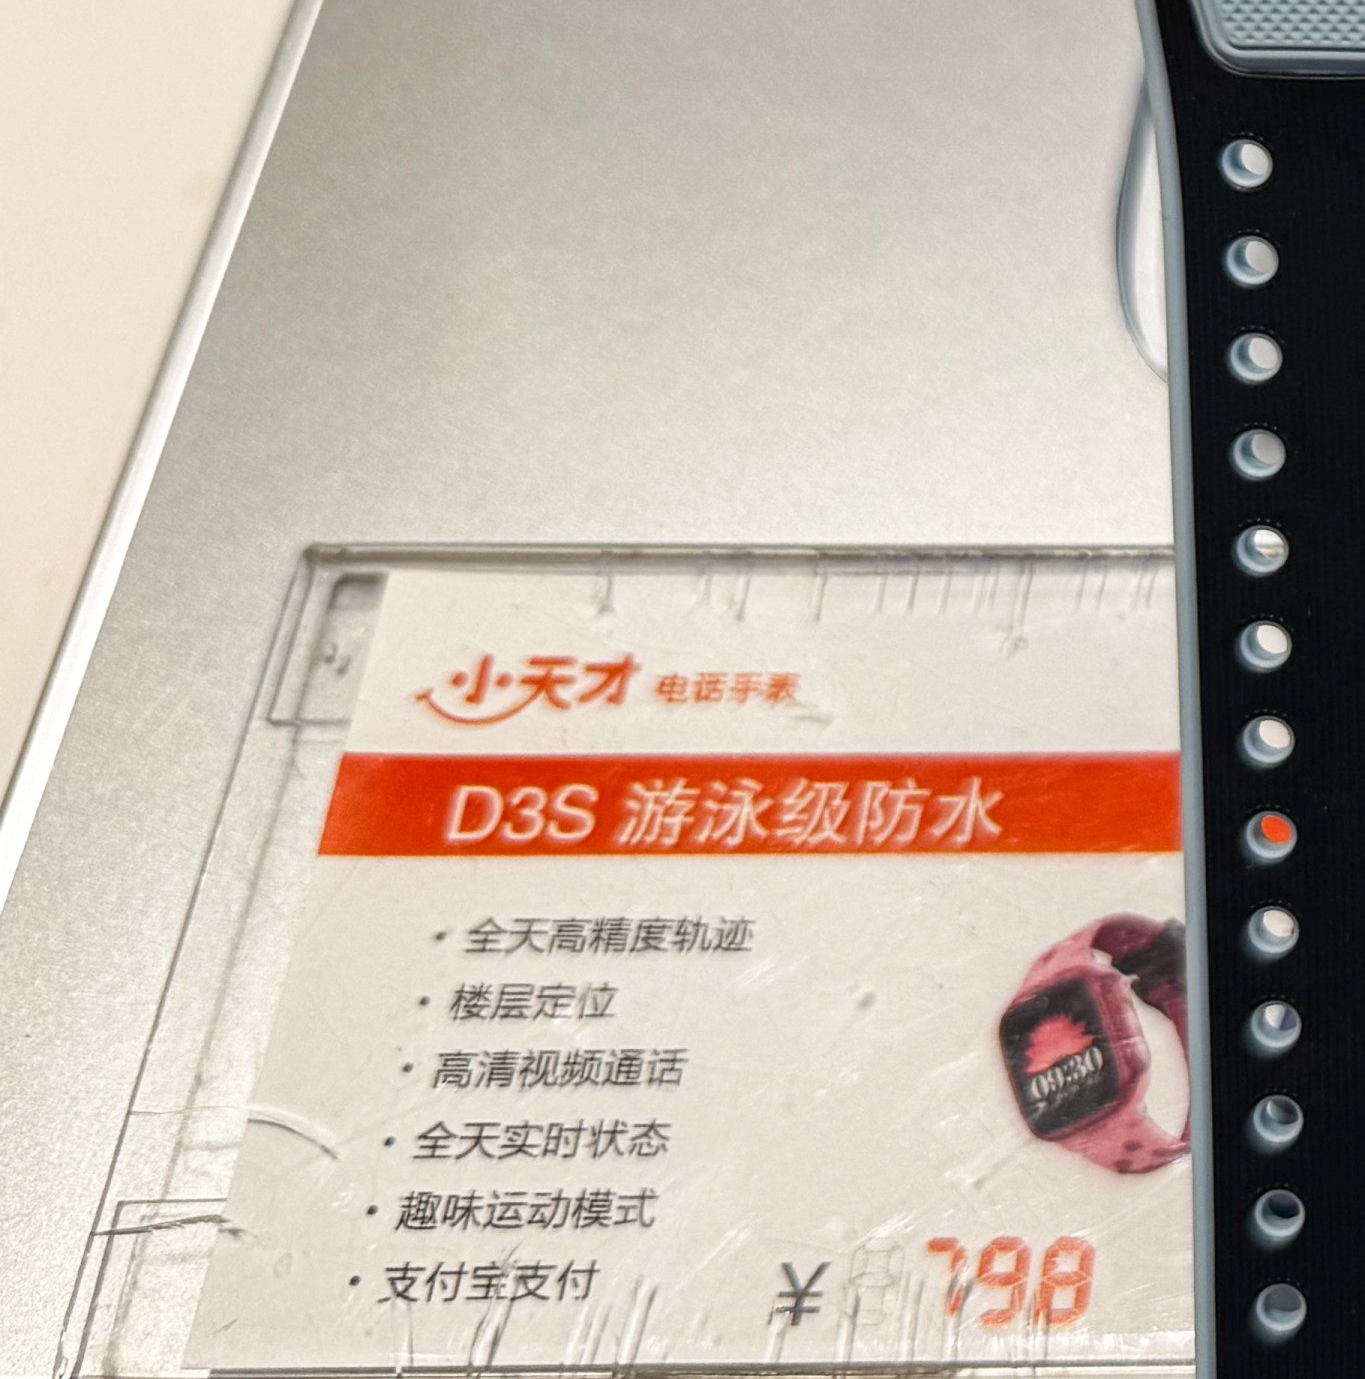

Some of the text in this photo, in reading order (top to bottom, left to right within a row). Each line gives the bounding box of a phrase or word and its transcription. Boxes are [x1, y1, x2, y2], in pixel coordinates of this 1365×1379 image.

[451, 652, 801, 710] 小天才 电话手表
[446, 777, 1004, 847] D3S 游泳级防水
[464, 917, 756, 955] 全天高精度轨迹
[451, 981, 619, 1021] 楼层定位
[432, 1049, 689, 1089] 高清视频通话
[413, 1118, 672, 1160] 全天实时状态
[395, 1188, 659, 1231] 趣味运动模式
[378, 1258, 601, 1303] 支付宝支付
[925, 1235, 1096, 1328] 798
